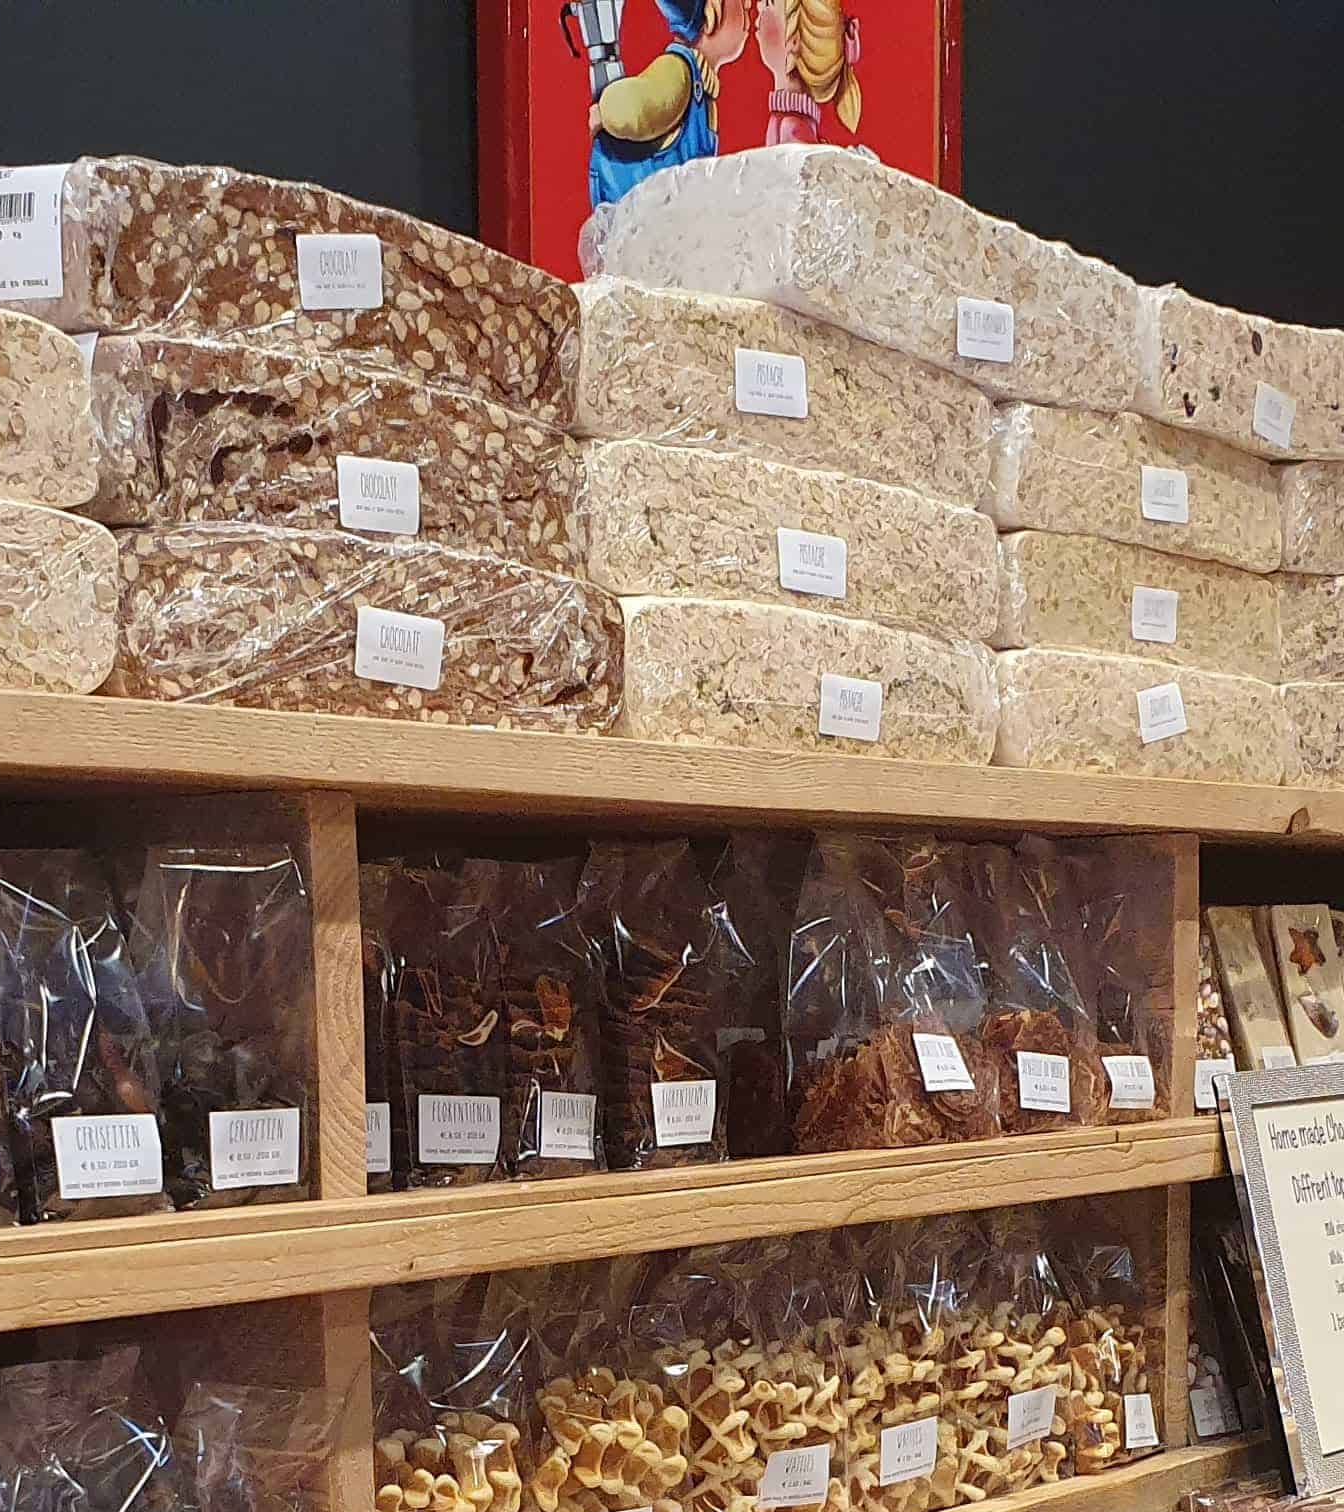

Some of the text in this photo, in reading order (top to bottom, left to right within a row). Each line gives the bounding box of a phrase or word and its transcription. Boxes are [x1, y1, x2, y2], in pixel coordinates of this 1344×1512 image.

[75, 1124, 140, 1151] CERISETTEN
[1267, 1119, 1298, 1151] Home
[1299, 1115, 1326, 1146] made
